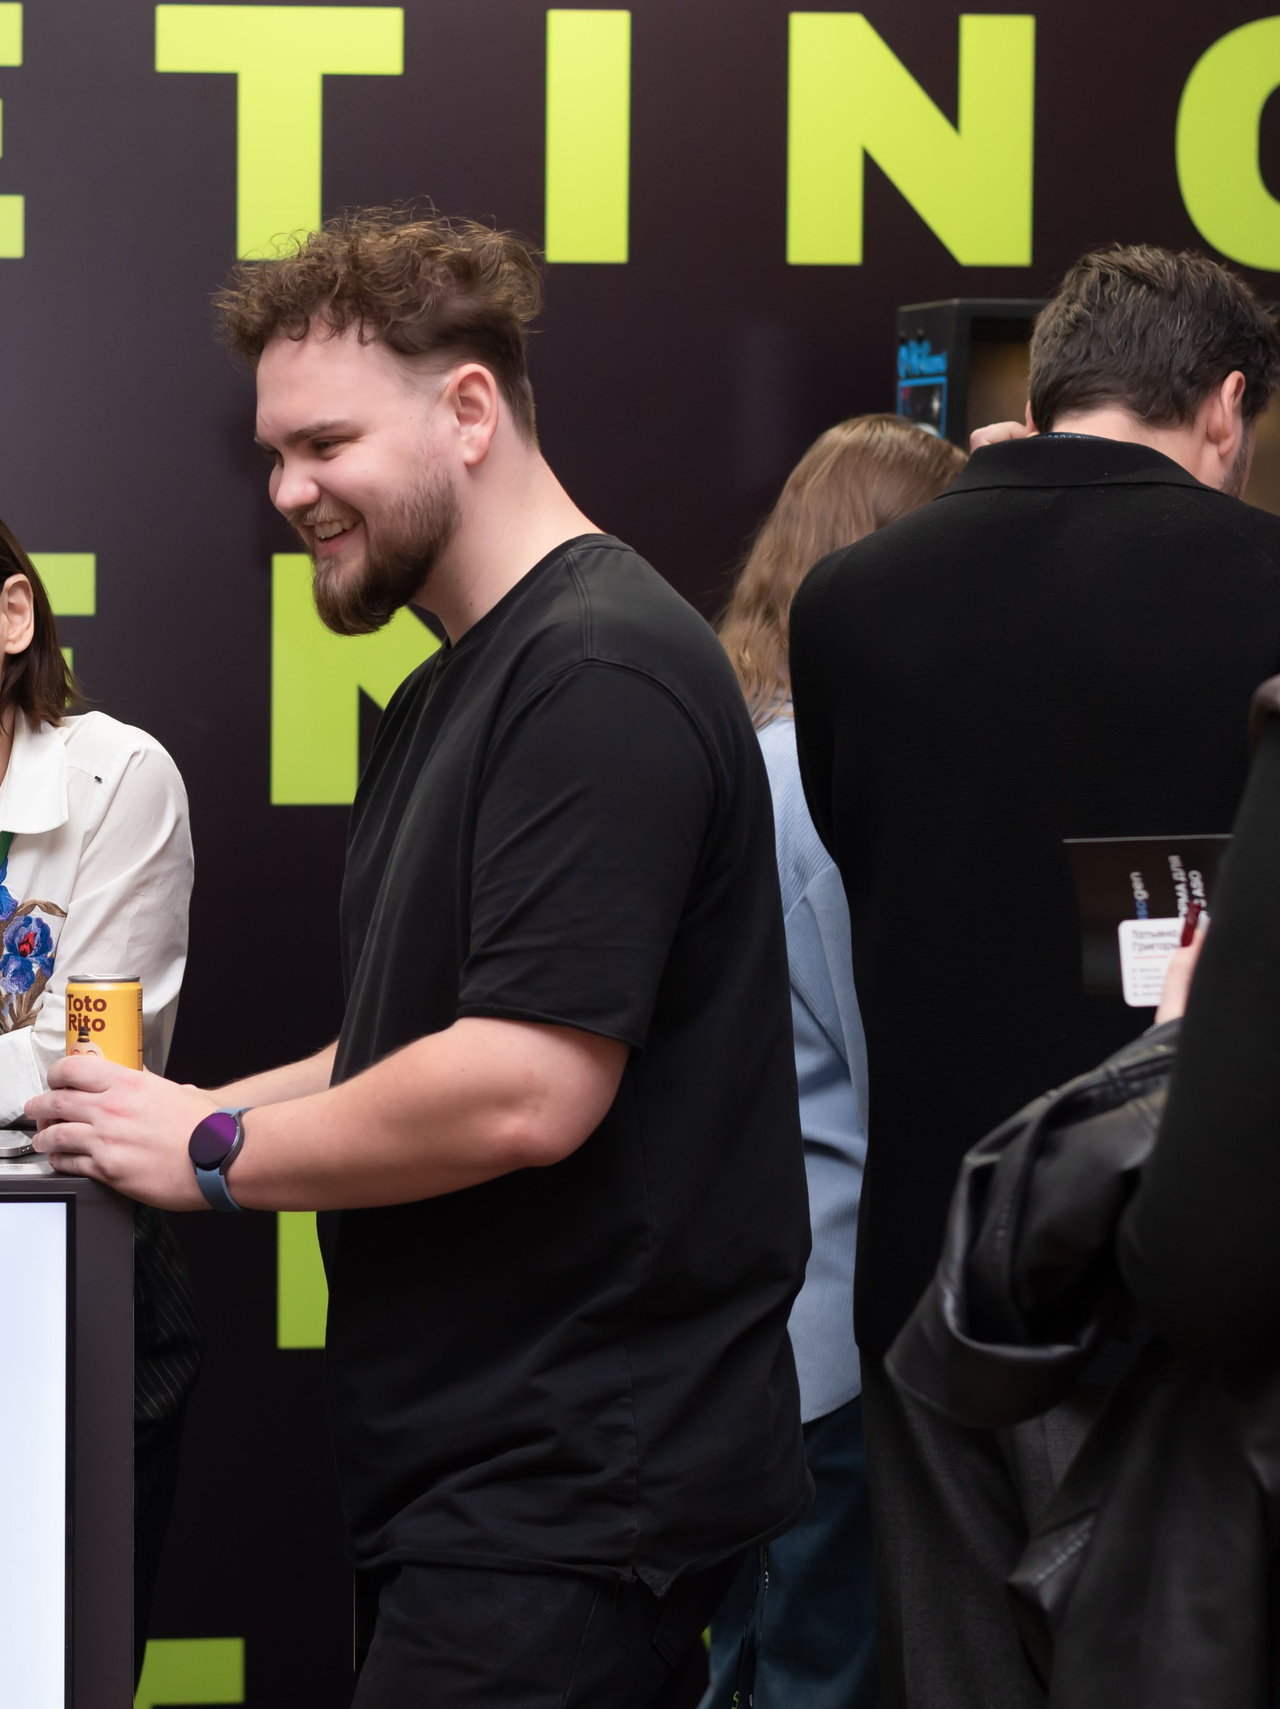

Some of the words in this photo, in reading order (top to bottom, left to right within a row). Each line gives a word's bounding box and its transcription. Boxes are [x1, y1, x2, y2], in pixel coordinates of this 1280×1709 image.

[1130, 872, 1149, 919] sogen
[67, 994, 107, 1012] Toto
[68, 1013, 106, 1032] Rito
